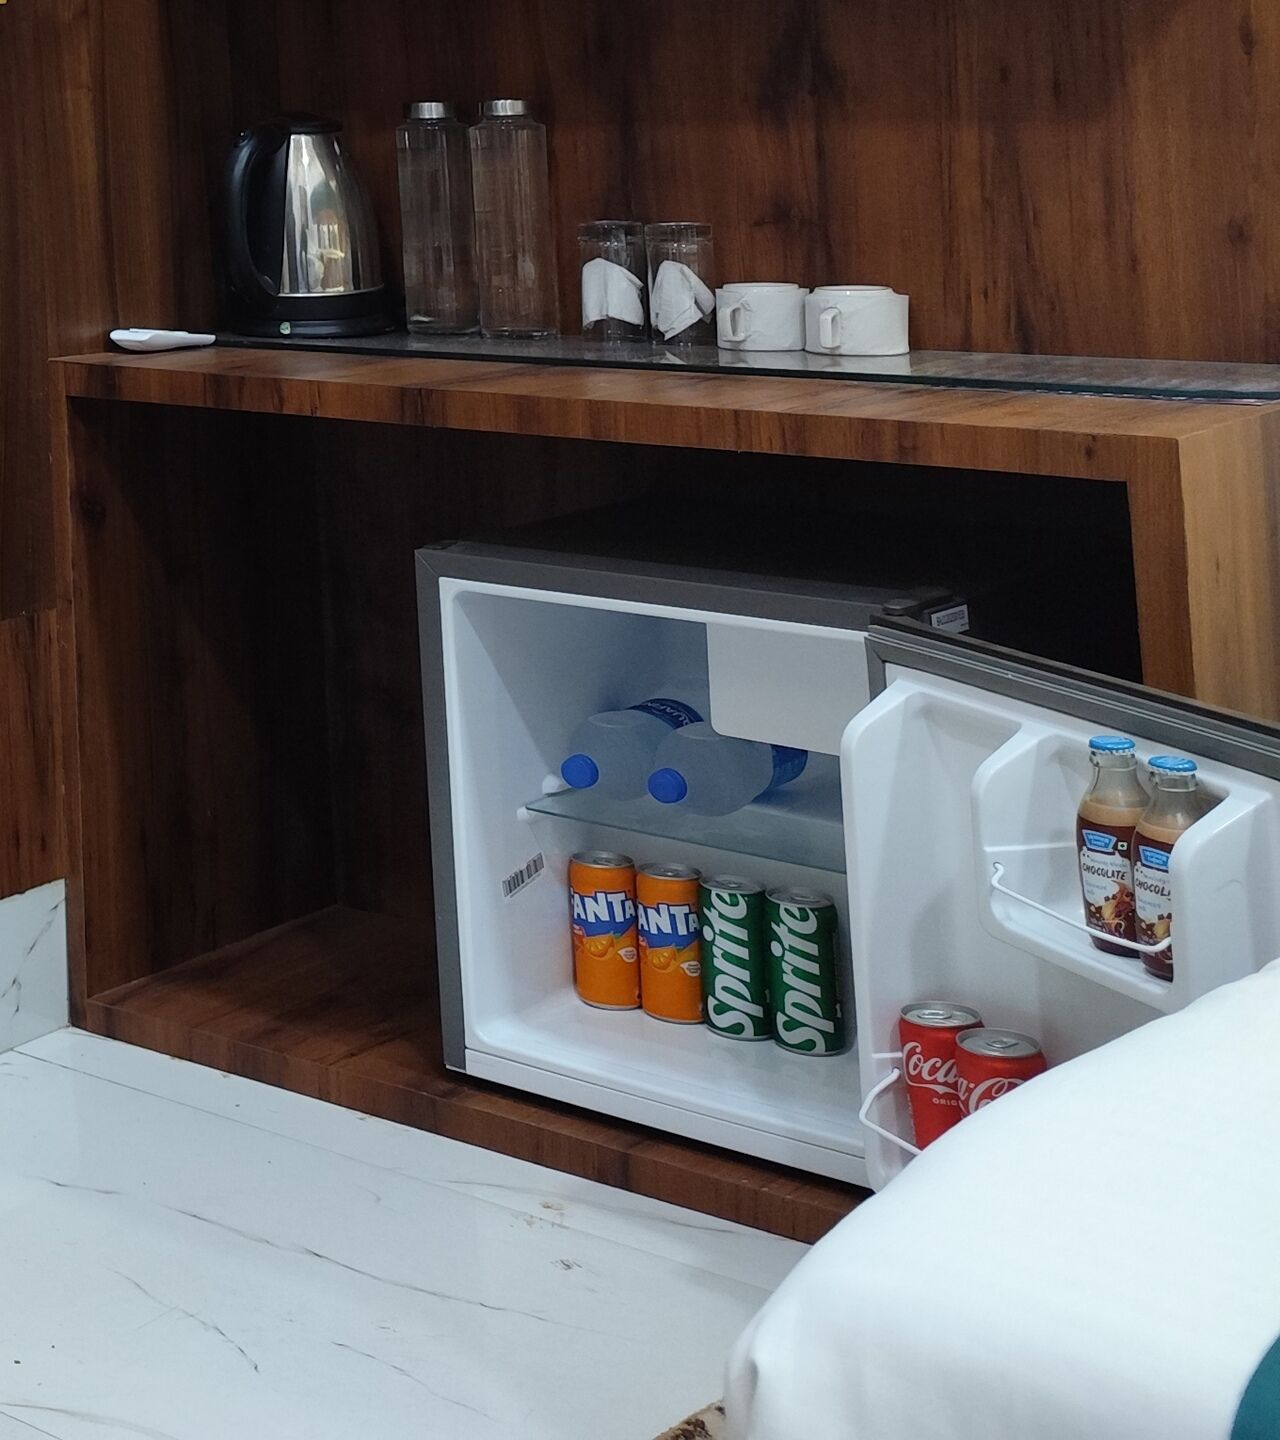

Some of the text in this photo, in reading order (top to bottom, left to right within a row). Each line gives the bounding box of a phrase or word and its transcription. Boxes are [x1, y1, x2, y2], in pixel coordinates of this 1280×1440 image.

[1082, 861, 1128, 882] CHOCOLATE
[570, 888, 637, 924] ANTA
[638, 901, 701, 936] ANTA
[701, 888, 765, 1038] Sprite
[770, 902, 836, 1055] Sprite
